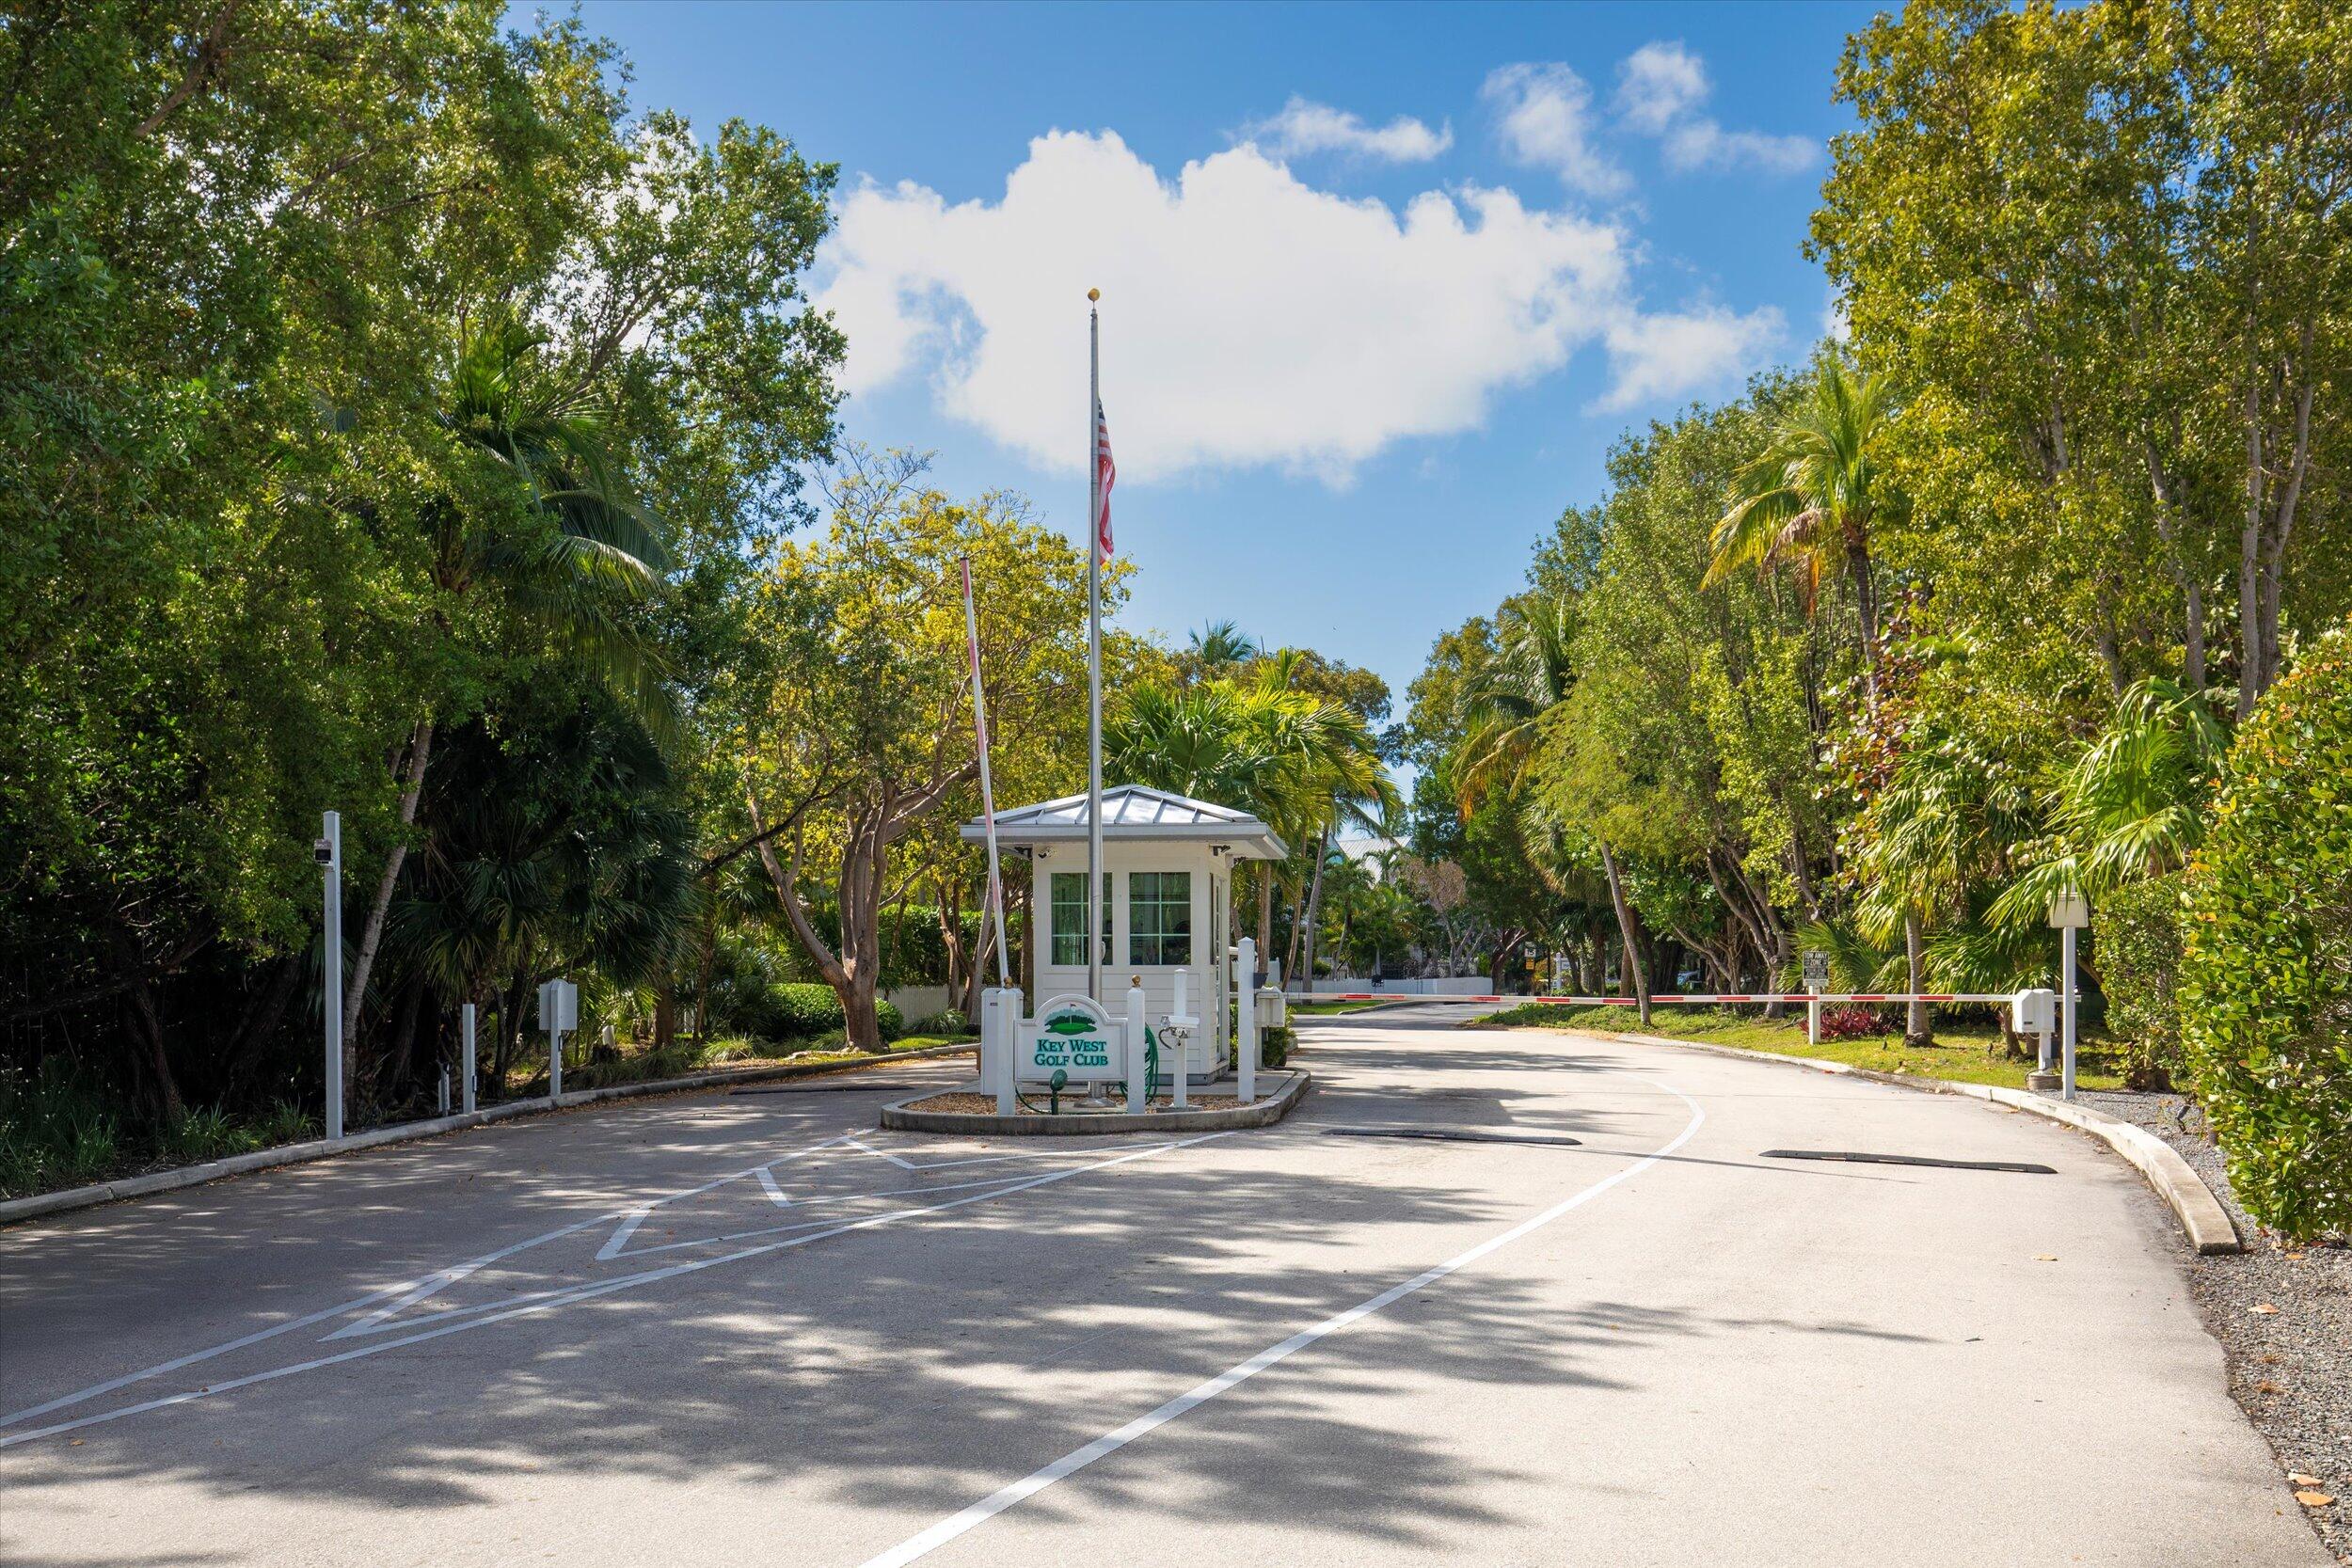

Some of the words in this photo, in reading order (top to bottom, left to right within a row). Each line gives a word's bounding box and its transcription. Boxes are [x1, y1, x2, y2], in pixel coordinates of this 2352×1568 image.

[1037, 1038, 1066, 1053] KEY
[1068, 1038, 1107, 1053] WEST
[1034, 1053, 1071, 1067] GOLF
[1073, 1053, 1109, 1067] CLUB
